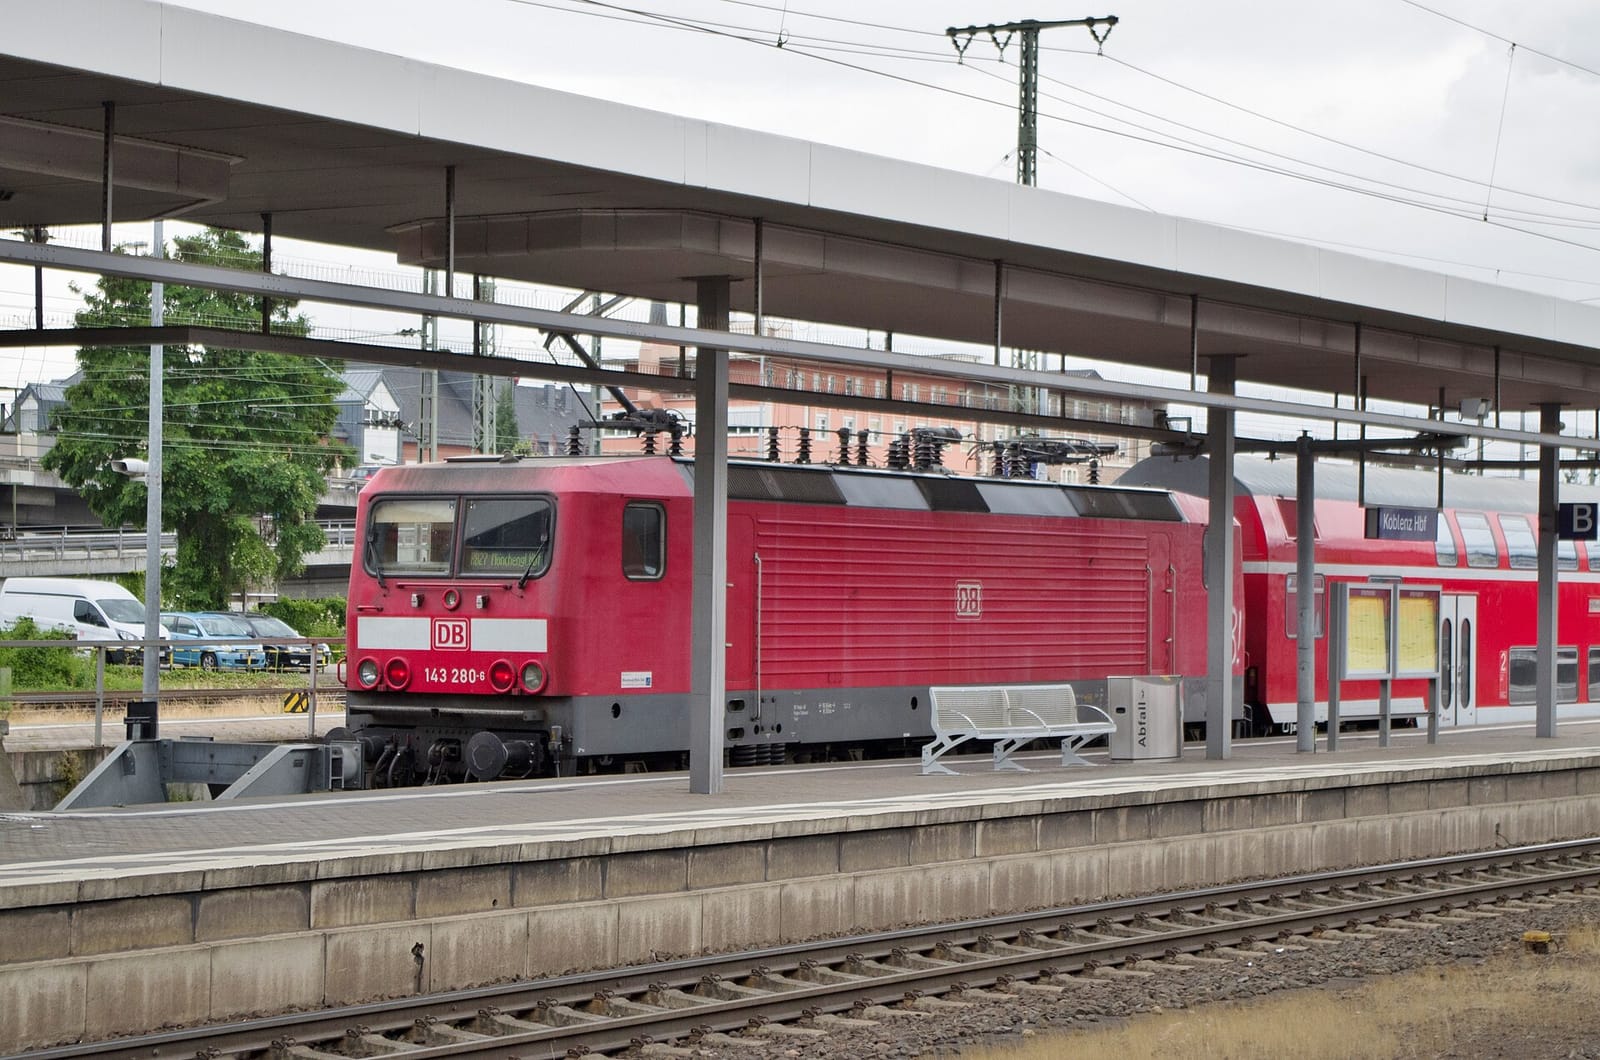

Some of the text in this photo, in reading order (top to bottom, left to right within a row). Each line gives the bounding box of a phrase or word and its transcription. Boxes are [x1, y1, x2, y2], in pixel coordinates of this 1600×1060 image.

[1383, 513, 1427, 532] Koblenz Hbf
[1573, 504, 1593, 532] B
[959, 587, 979, 613] DB
[437, 623, 465, 645] DB
[424, 667, 486, 684] 143 280-6
[1137, 701, 1147, 748] Abfall
